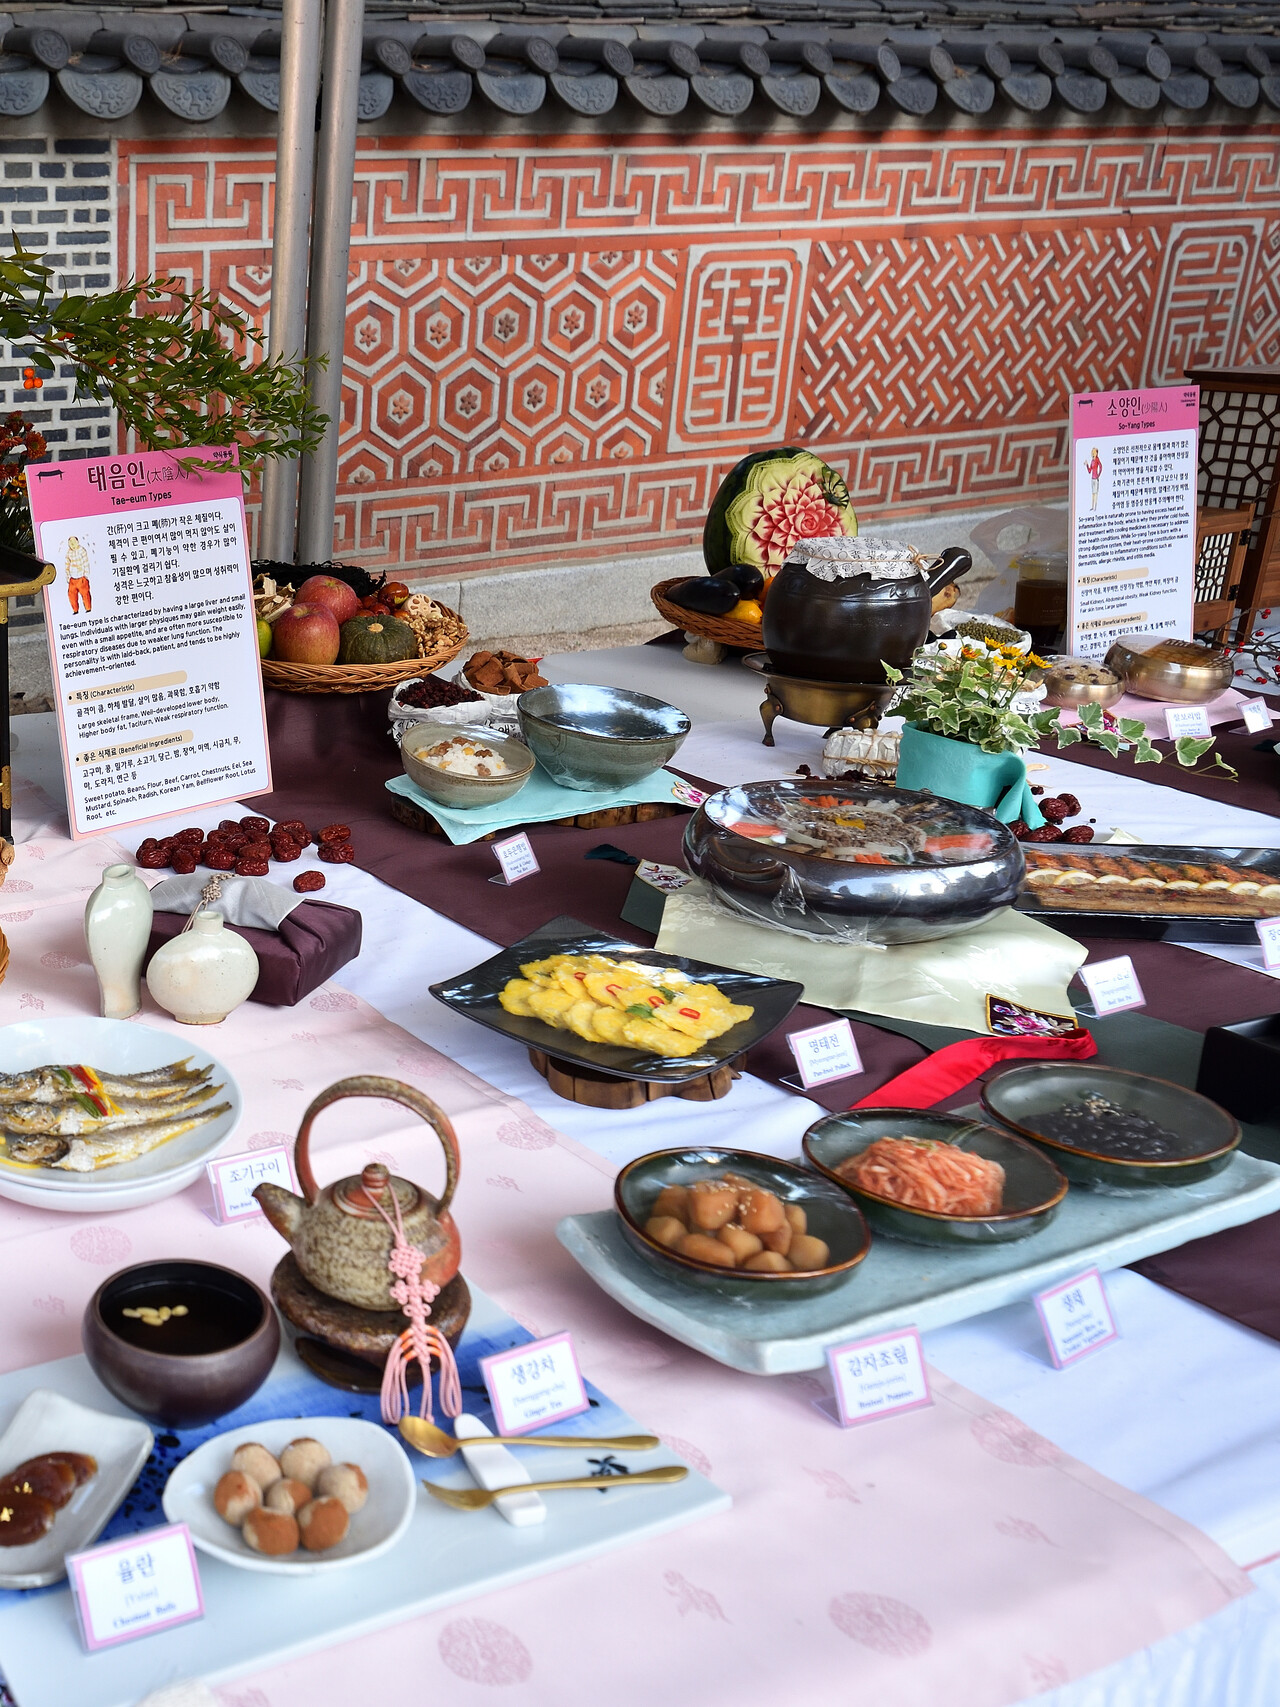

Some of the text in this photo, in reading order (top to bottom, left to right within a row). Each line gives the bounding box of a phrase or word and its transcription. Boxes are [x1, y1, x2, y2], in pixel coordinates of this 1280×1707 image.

[1118, 420, 1155, 430] So-Yang Types
[110, 491, 172, 506] Tae-eum Types
[59, 621, 87, 630] Tae-eum
[88, 618, 103, 627] type
[109, 608, 153, 623] characterized
[162, 604, 183, 613] having
[188, 601, 204, 609] large
[219, 595, 231, 604] and
[230, 593, 245, 602] small
[65, 659, 136, 678] achievement-oriented.
[808, 1033, 840, 1054] 명태전
[229, 1158, 280, 1183] 조기구이
[511, 1353, 556, 1386] 생강차
[847, 1344, 909, 1377] 감자조림
